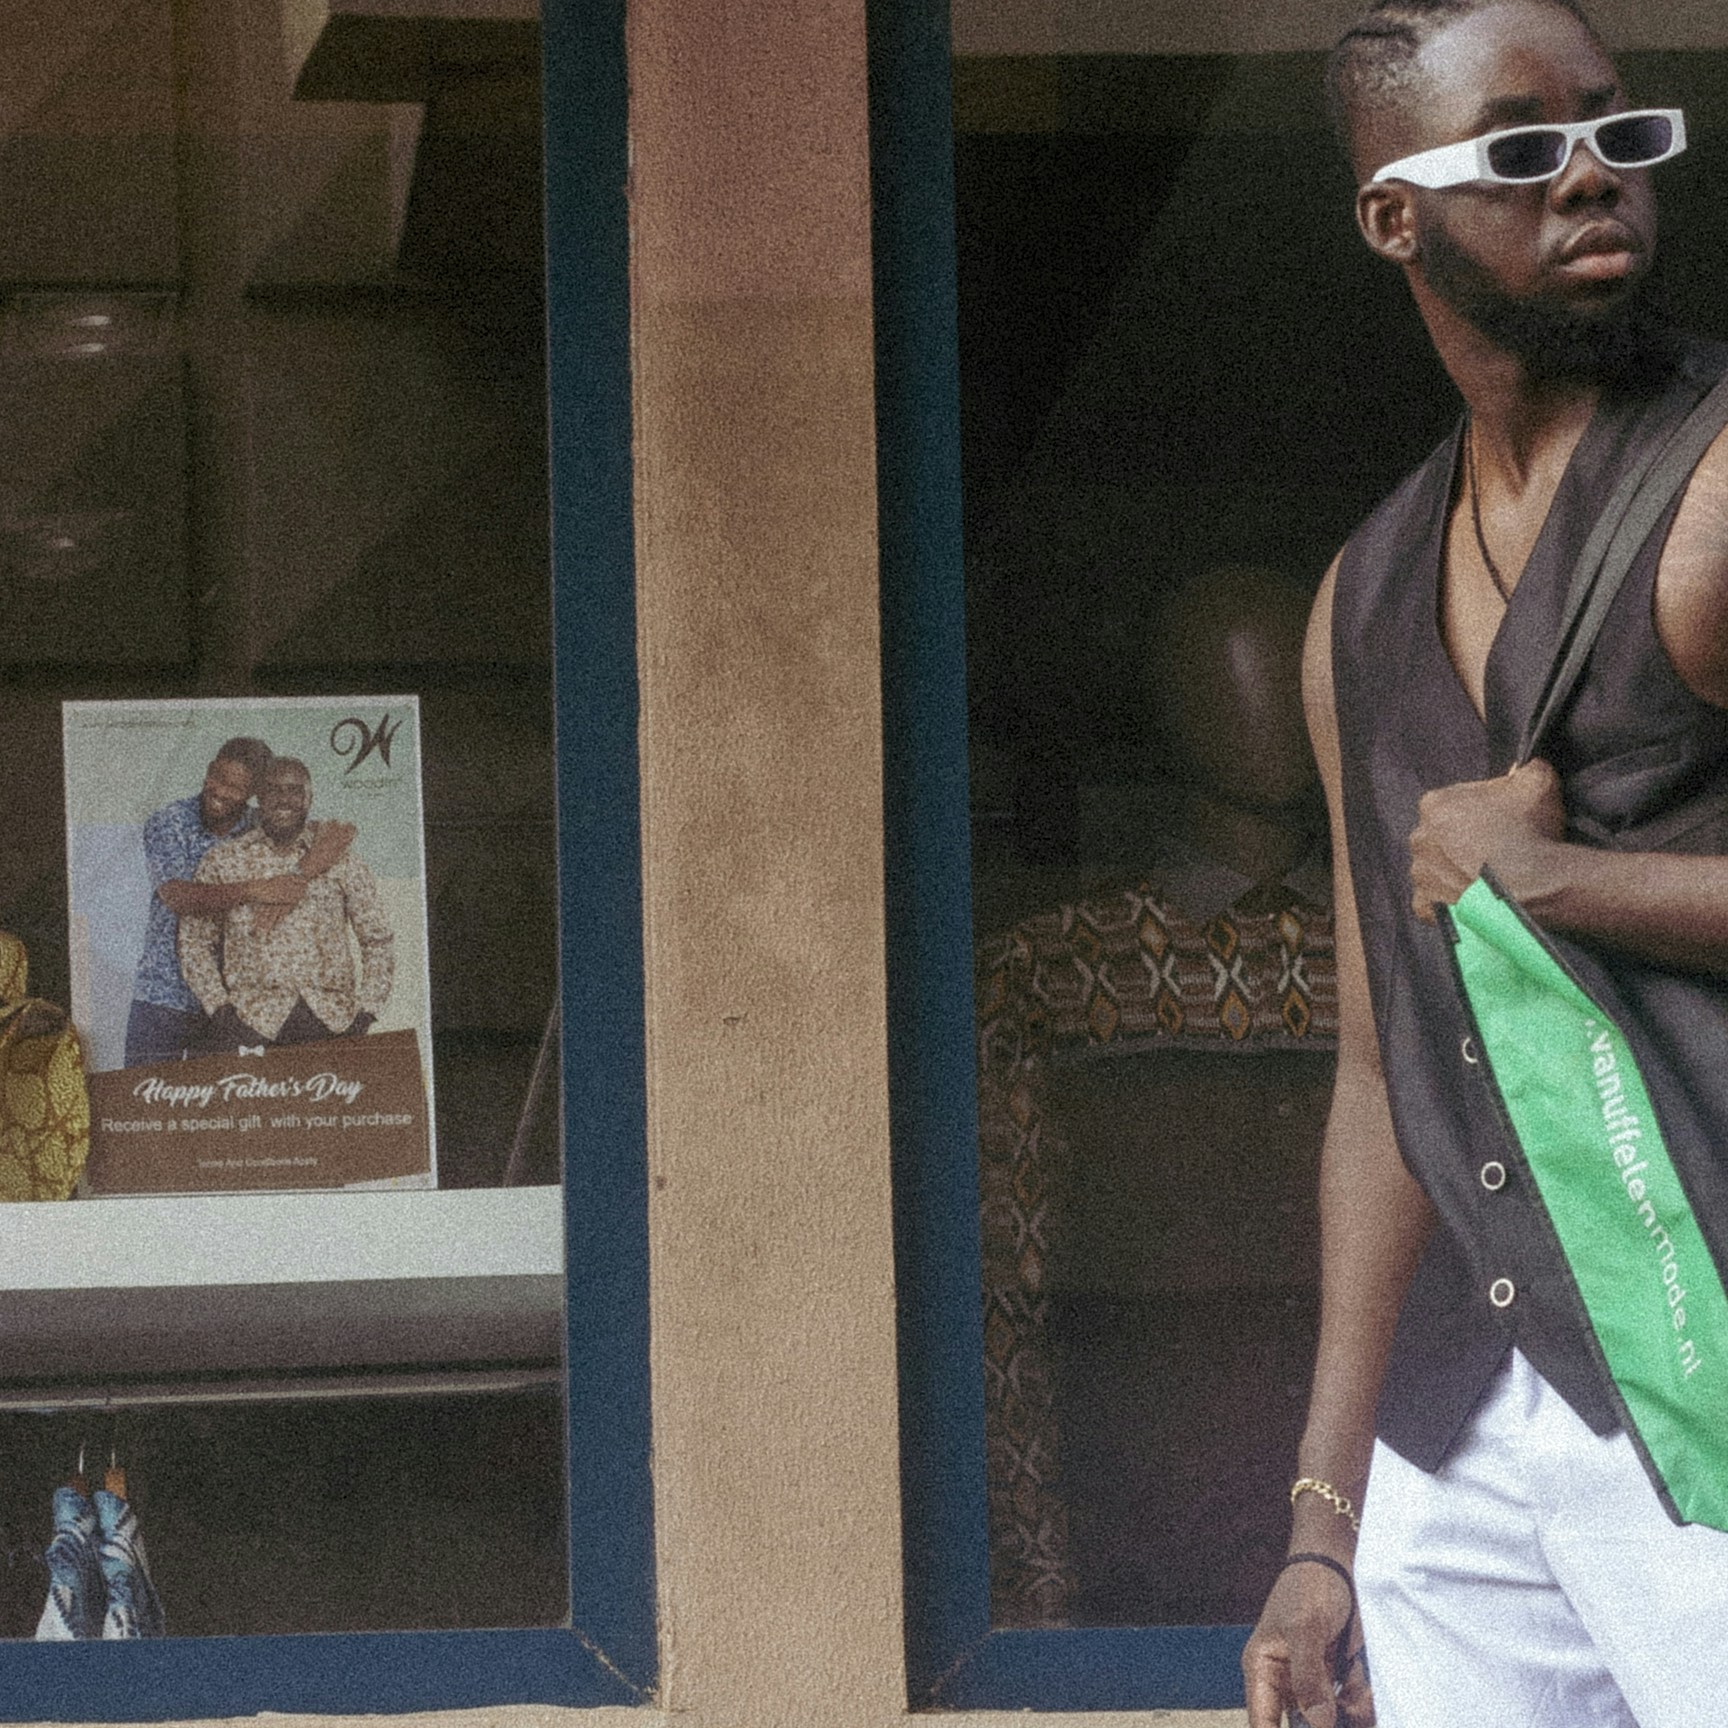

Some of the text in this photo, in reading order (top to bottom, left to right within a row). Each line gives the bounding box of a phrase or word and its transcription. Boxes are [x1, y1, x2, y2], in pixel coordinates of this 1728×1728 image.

[132, 1072, 364, 1108] Happy Father's Day
[100, 1112, 413, 1134] Receive a special gift with your purchase
